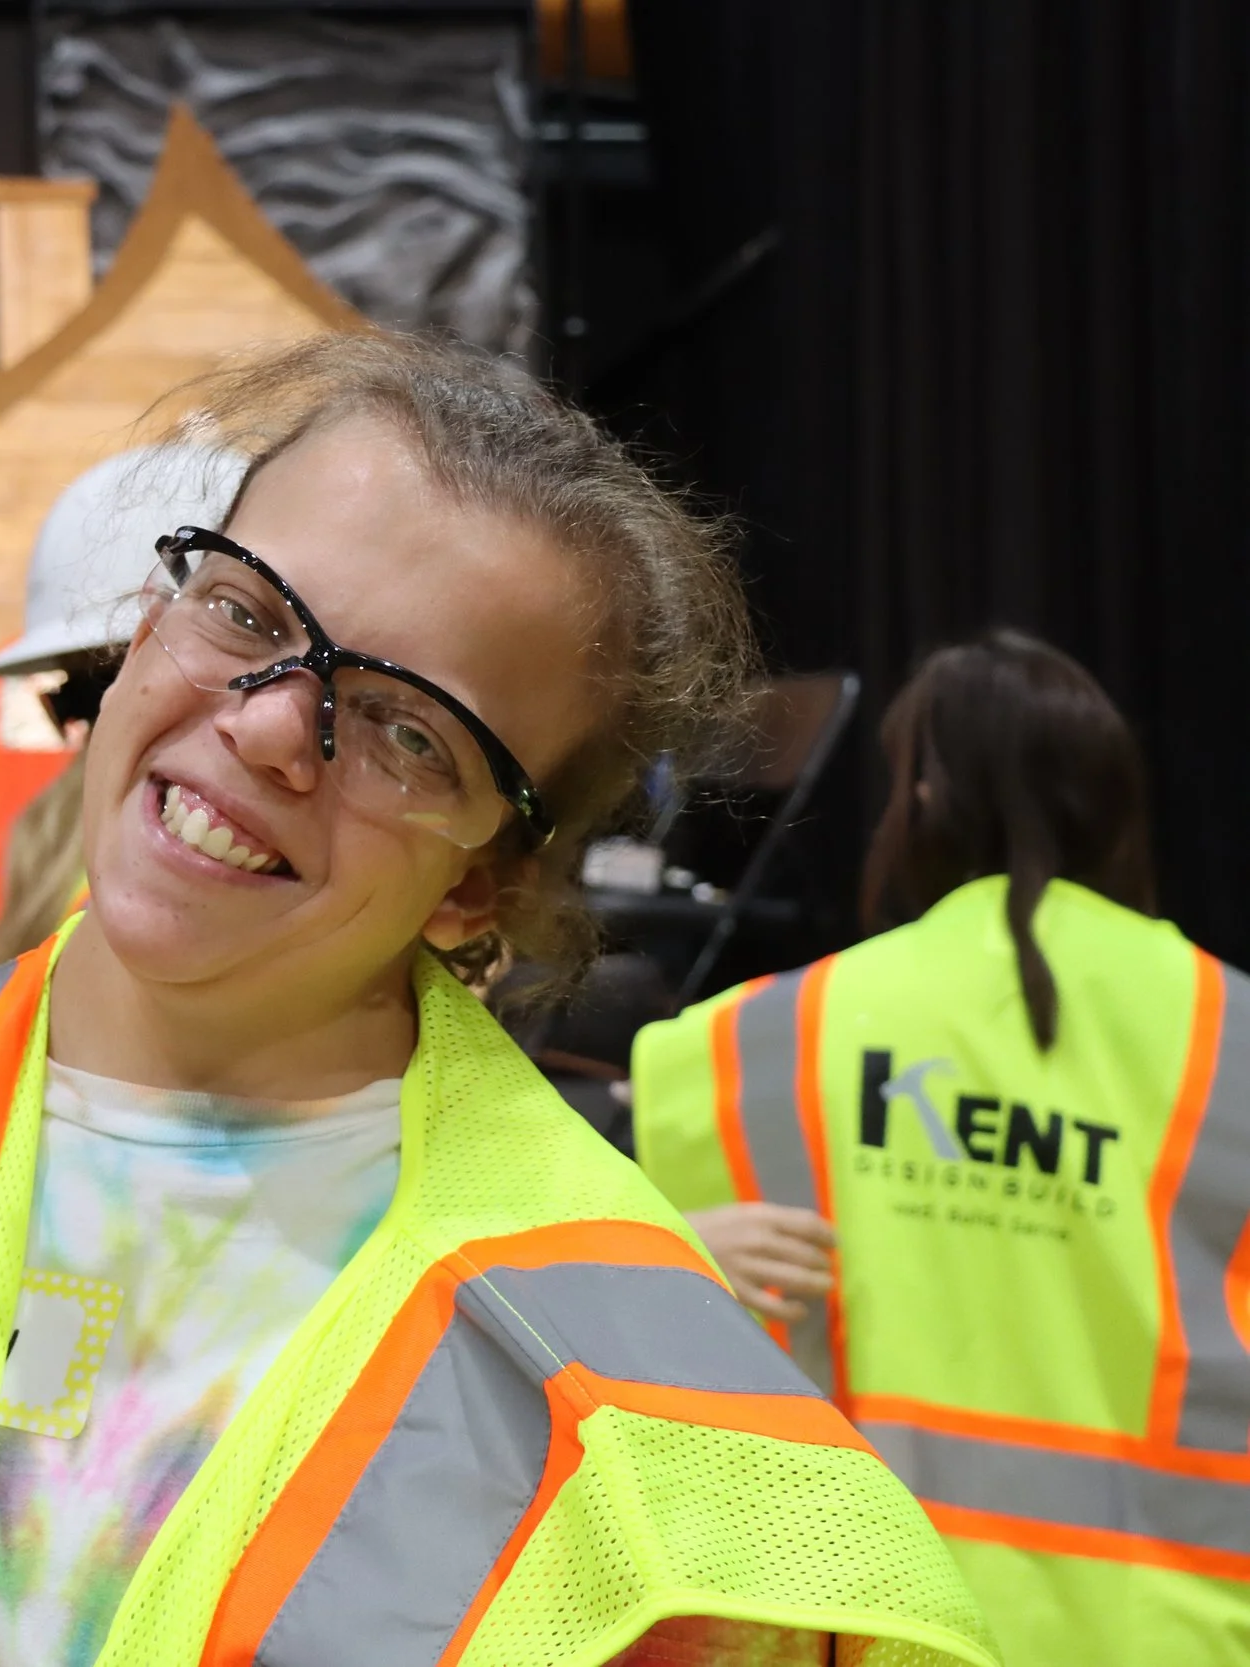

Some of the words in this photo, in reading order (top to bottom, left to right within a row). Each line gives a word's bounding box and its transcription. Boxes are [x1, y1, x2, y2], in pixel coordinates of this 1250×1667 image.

[859, 1049, 1119, 1186] KENT
[853, 1155, 989, 1193] DESIGN
[1002, 1175, 1117, 1221] BUILD
